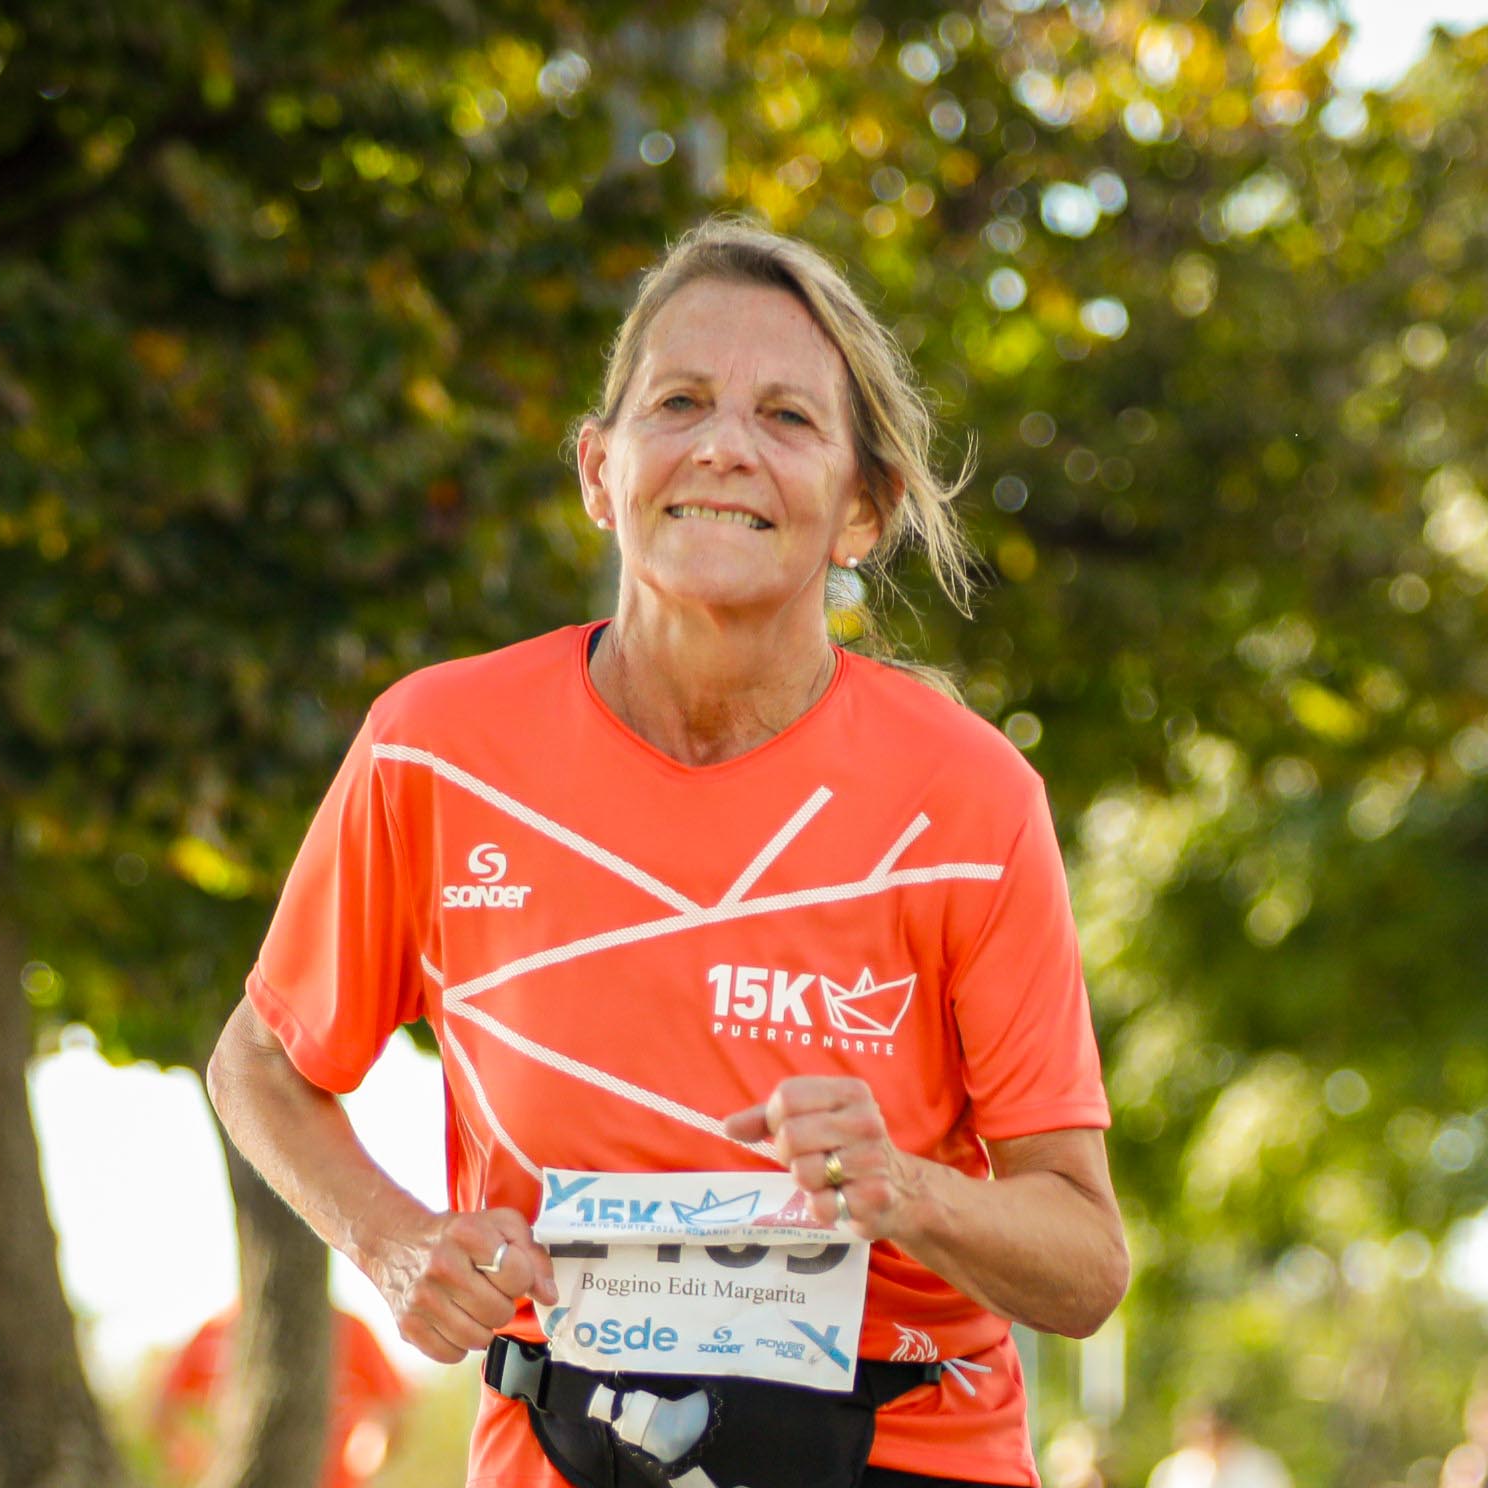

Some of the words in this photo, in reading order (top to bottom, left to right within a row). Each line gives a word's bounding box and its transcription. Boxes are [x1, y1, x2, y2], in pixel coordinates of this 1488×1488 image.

[707, 963, 816, 1026] 15K
[713, 1022, 812, 1046] PUERTO
[823, 1035, 894, 1056] NORTE
[576, 1198, 663, 1223] 15K
[581, 1272, 662, 1297] Boggino
[669, 1276, 707, 1296] Edit
[714, 1280, 807, 1305] Margarita
[574, 1316, 679, 1353] osde
[756, 1338, 806, 1353] POWER
